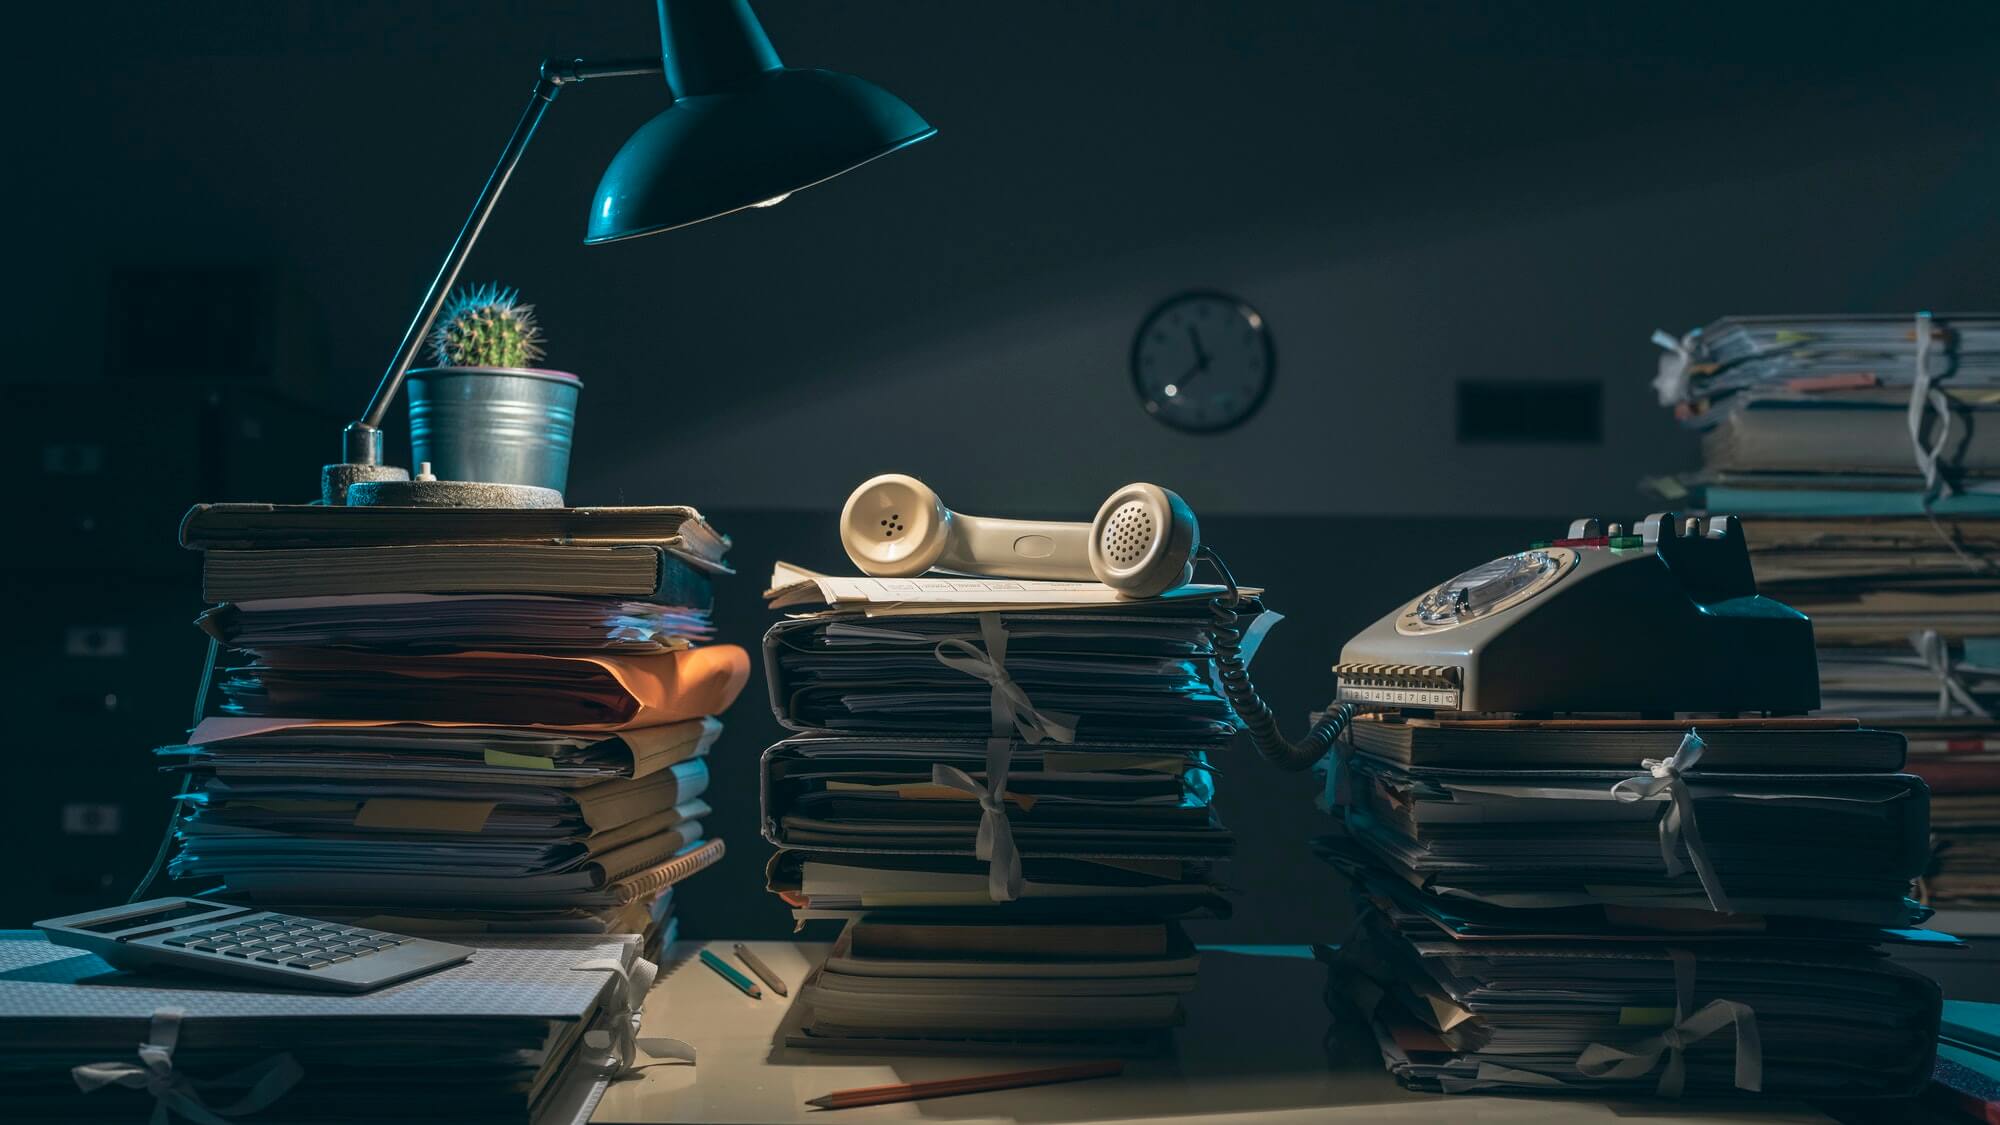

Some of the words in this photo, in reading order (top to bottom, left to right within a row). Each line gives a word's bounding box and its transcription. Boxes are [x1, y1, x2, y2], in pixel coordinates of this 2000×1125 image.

[1364, 691, 1369, 699] 3
[1409, 693, 1415, 701] 7
[1421, 694, 1426, 702] 8
[1446, 695, 1453, 703] 10
